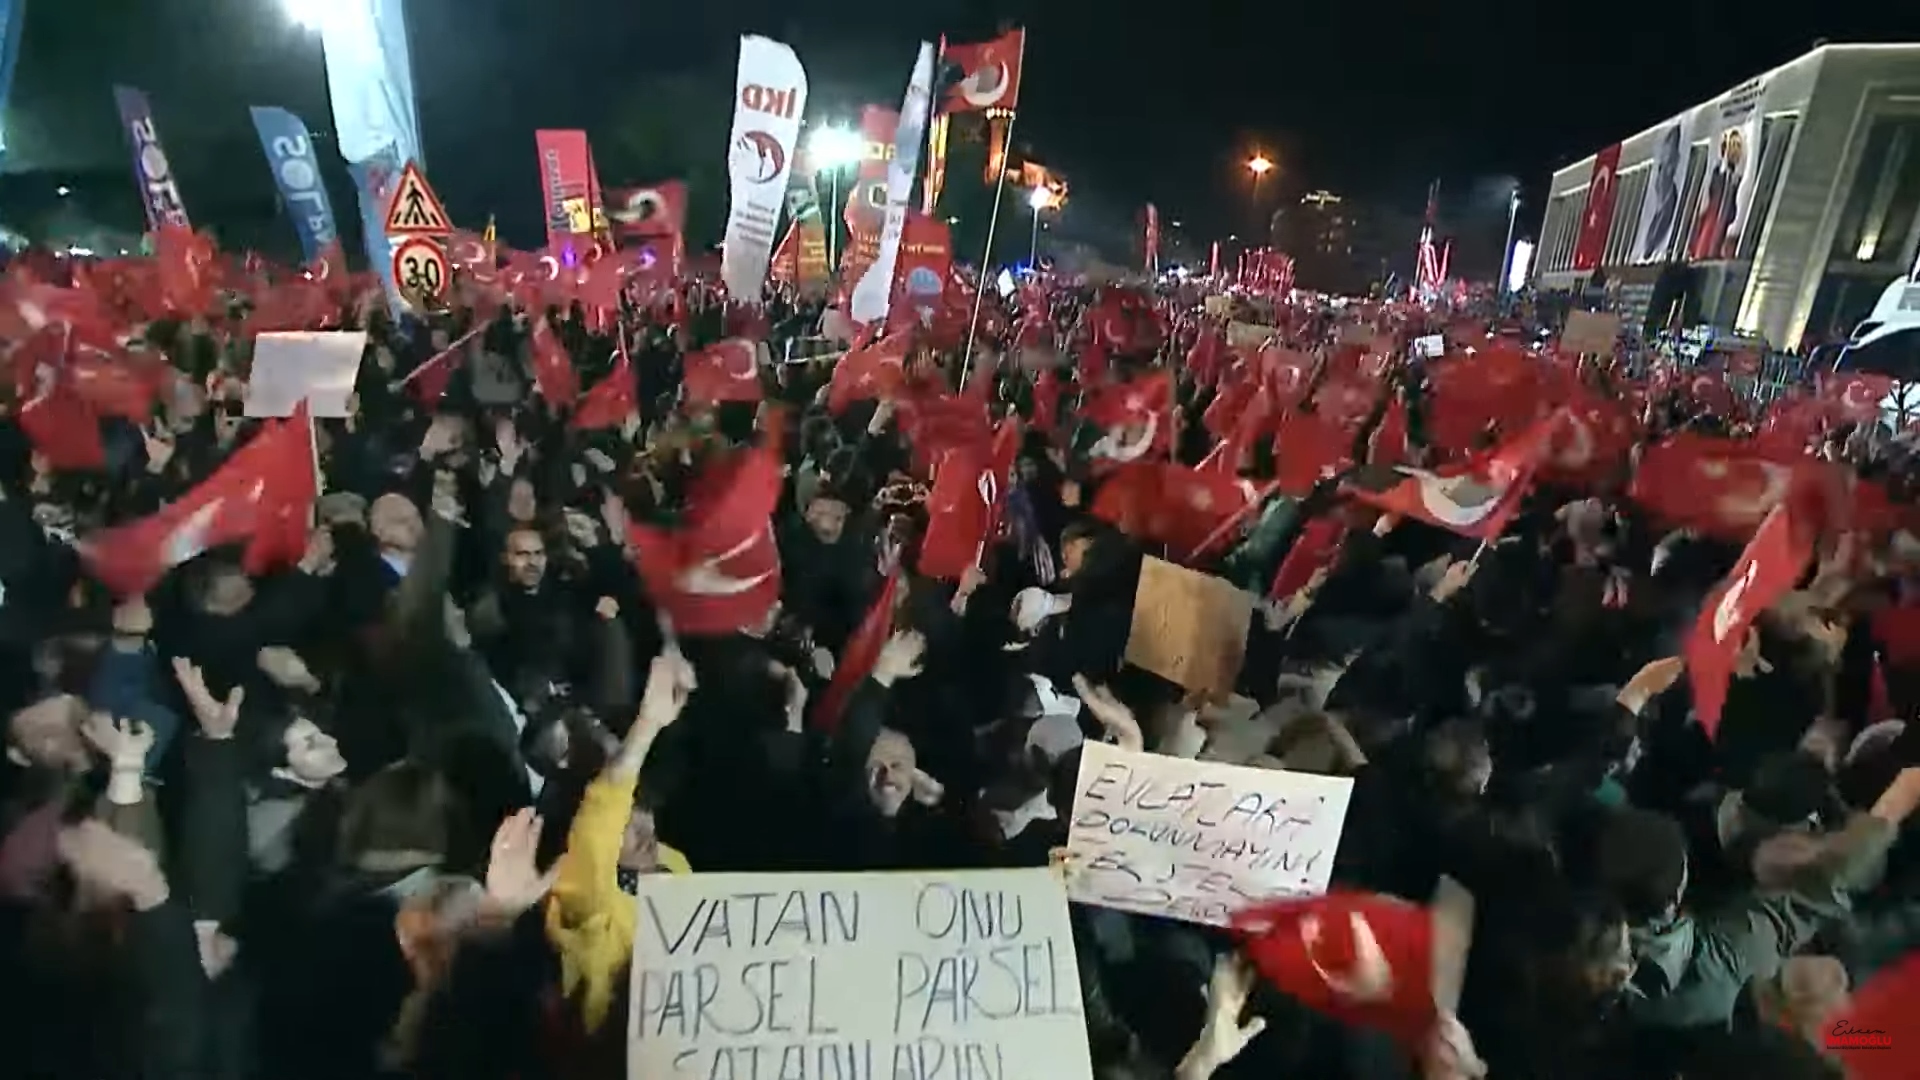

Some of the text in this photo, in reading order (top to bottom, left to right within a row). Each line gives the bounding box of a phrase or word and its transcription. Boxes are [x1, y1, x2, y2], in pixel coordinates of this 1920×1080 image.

[405, 257, 439, 288] 30
[645, 882, 1022, 954] VATAN ONU
[638, 937, 1081, 1039] PARSEL PARSEL
